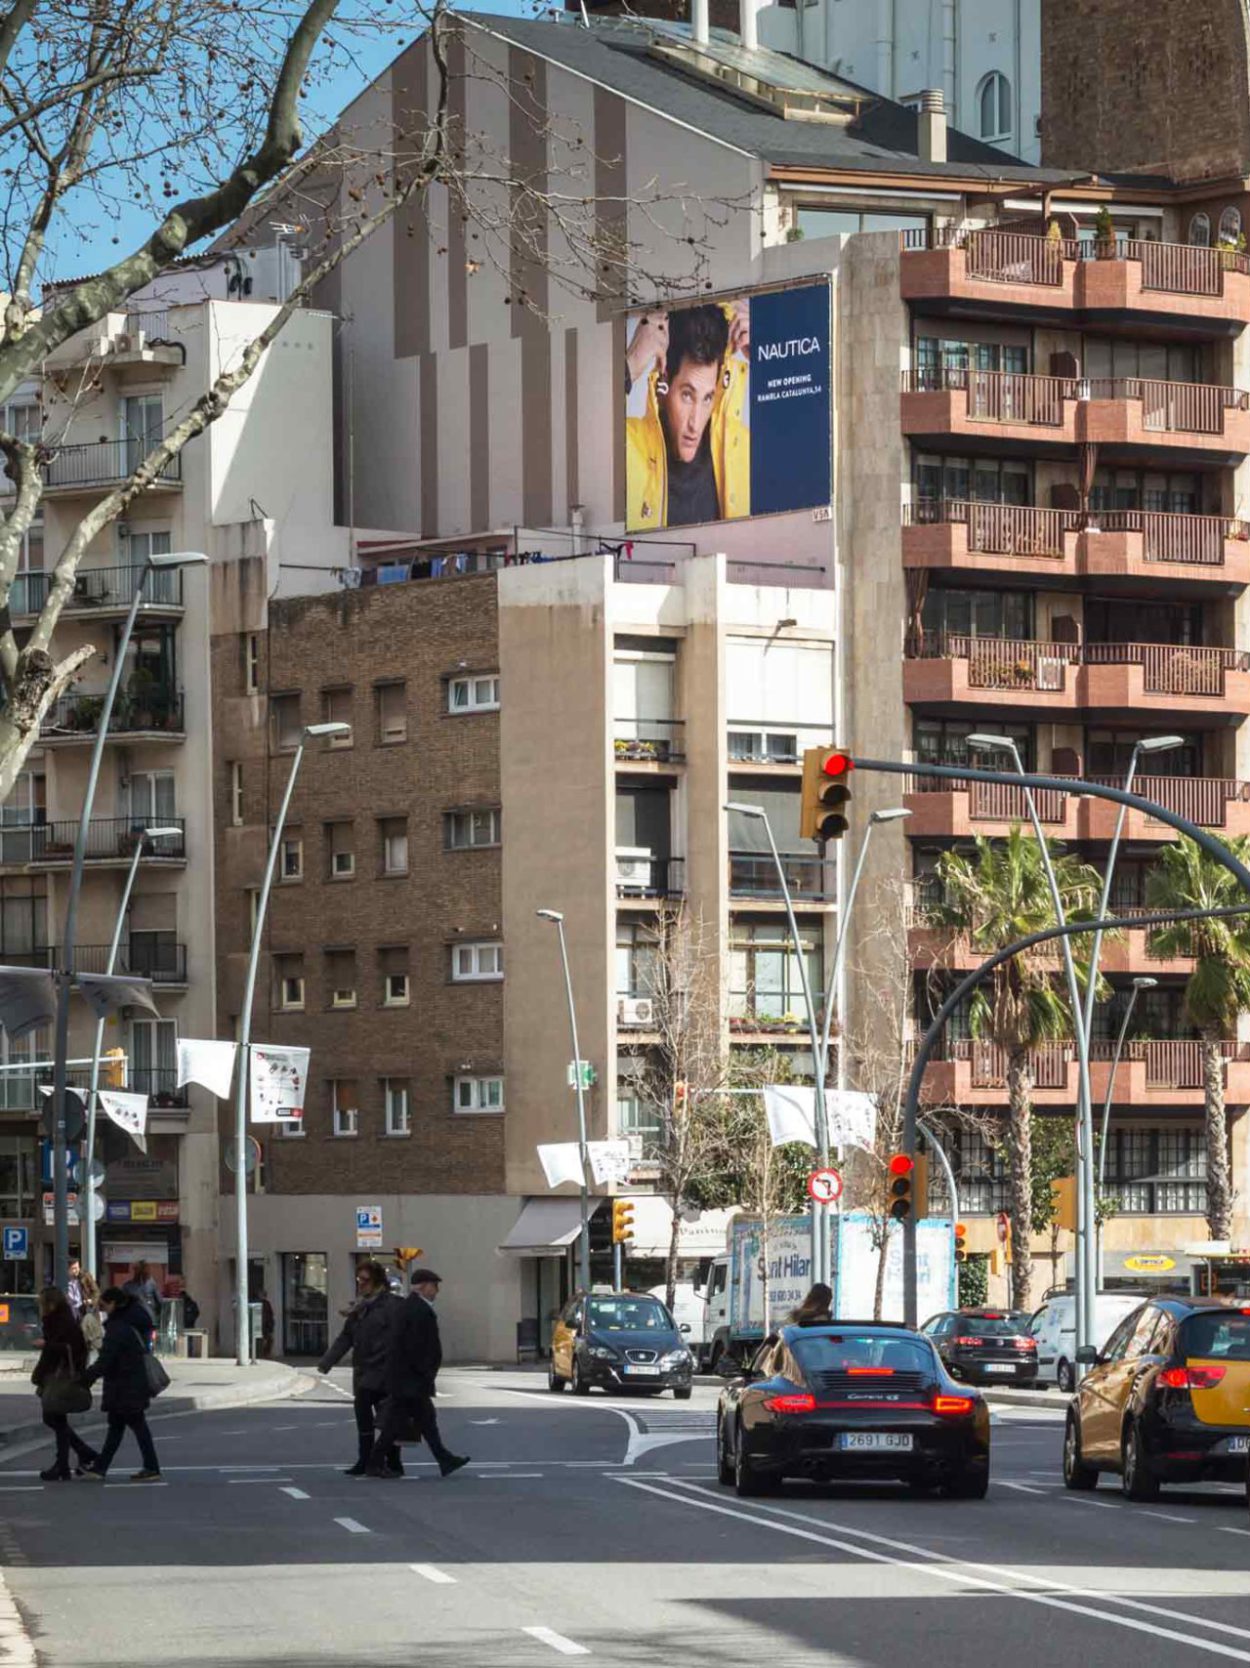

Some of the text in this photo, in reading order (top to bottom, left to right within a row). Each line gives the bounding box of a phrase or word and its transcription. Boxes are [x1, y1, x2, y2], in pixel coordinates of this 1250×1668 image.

[758, 337, 820, 361] NAUTICA
[783, 374, 811, 386] OPENING
[9, 1230, 22, 1249] P
[849, 1434, 910, 1447] 2691 GJD
